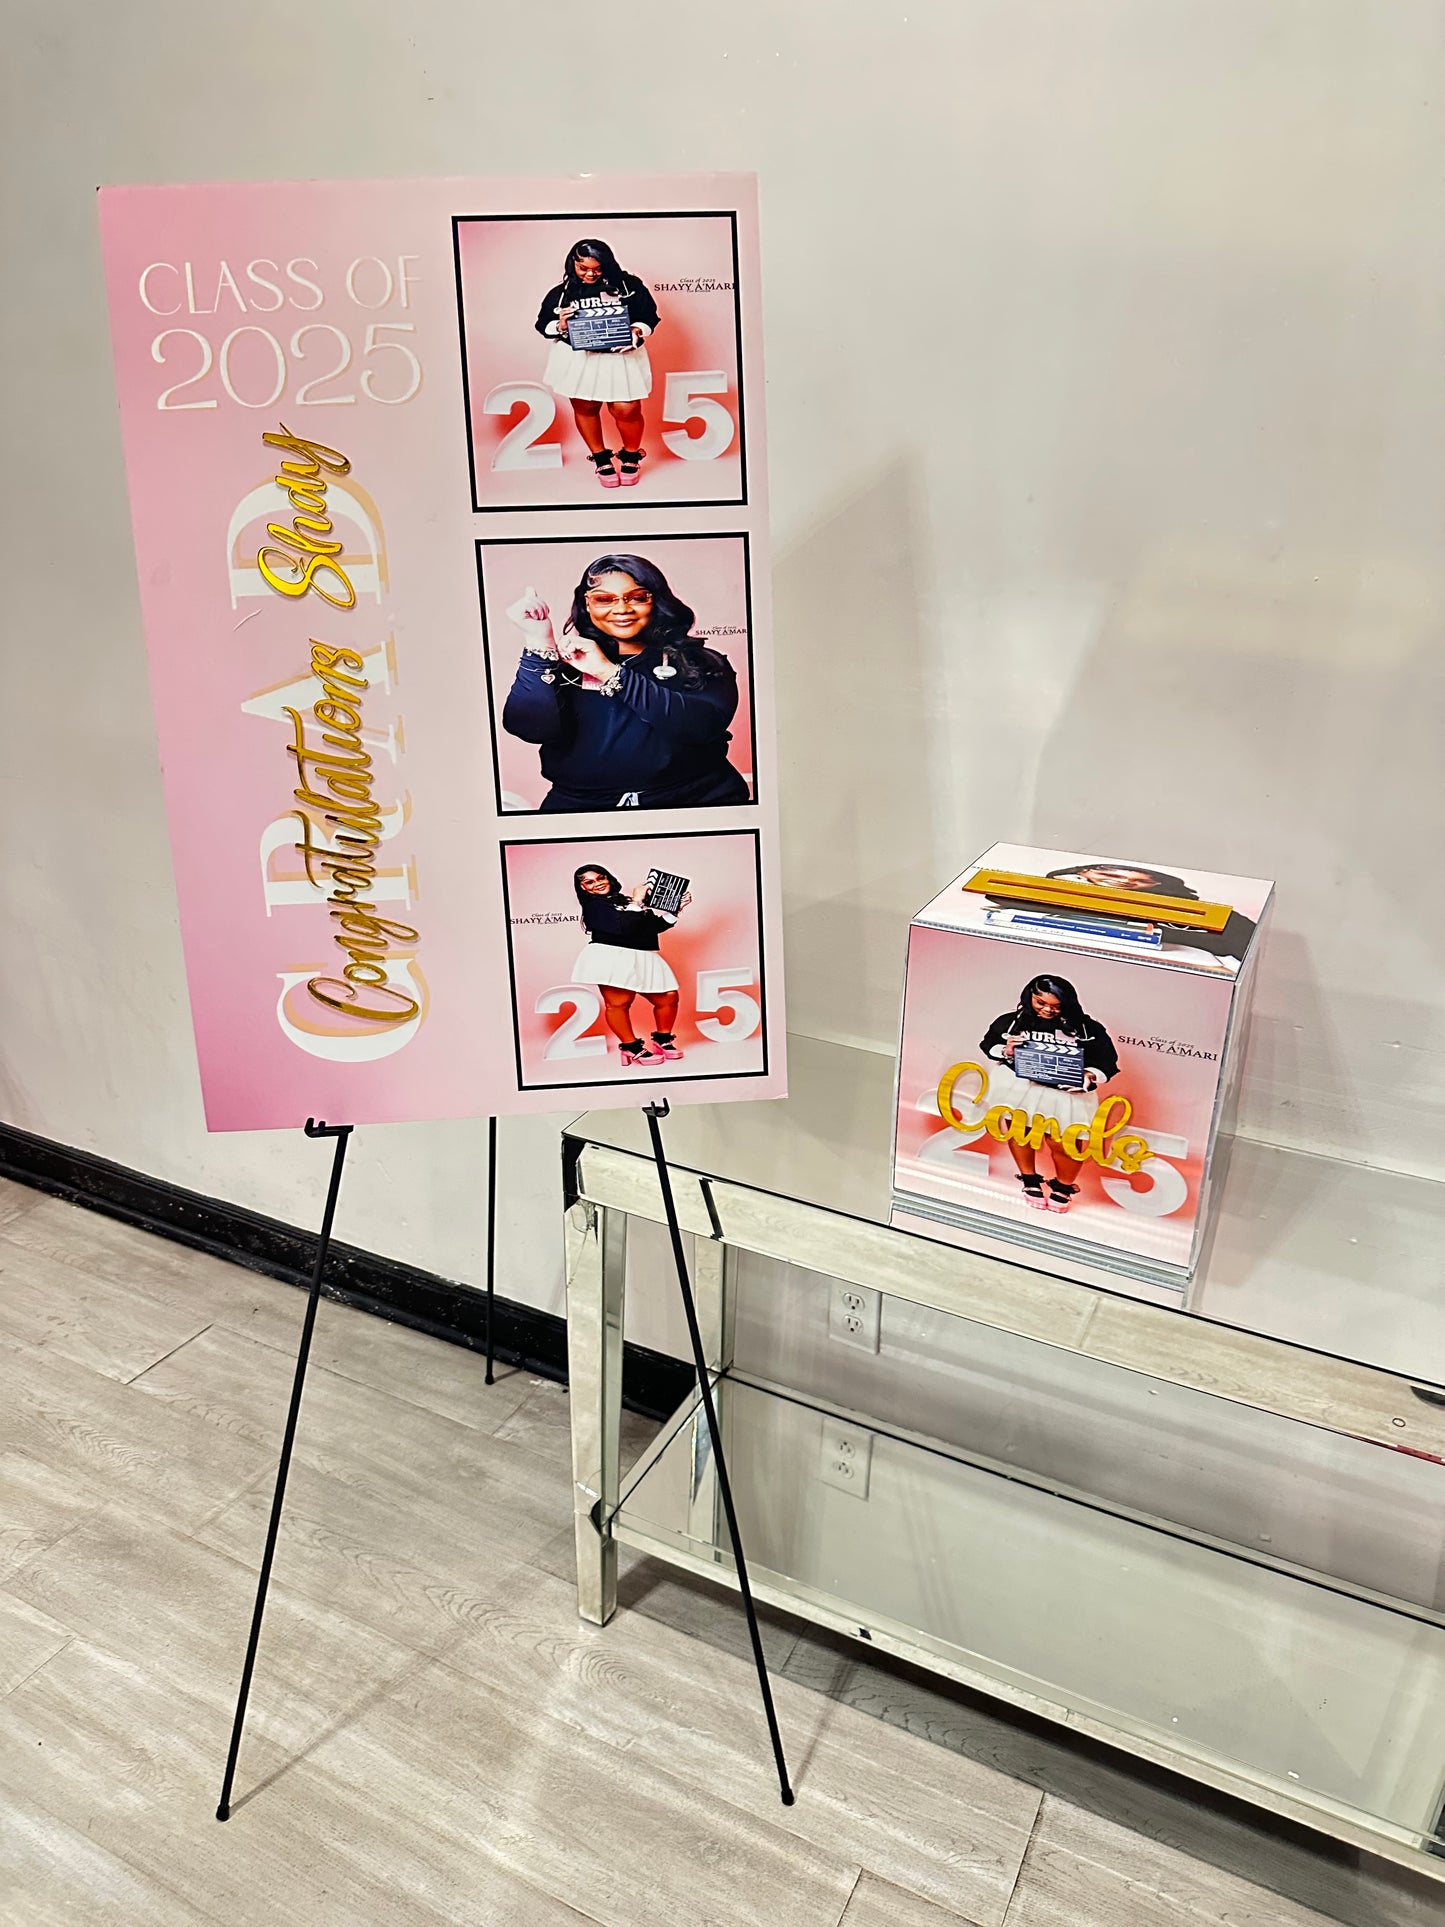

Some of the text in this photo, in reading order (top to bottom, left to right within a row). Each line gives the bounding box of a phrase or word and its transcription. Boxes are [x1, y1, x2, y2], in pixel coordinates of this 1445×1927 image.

[139, 255, 423, 316] CLASS OF
[653, 283, 693, 292] SHAYY
[151, 322, 423, 411] 2025
[483, 370, 735, 472] 2 5
[227, 474, 426, 1063] GRAD
[261, 422, 420, 1022] Congratulations Shay
[535, 967, 761, 1060] 2 5
[1117, 1035, 1164, 1051] SHAYY
[1166, 1045, 1218, 1061] A'MARI
[936, 1061, 1155, 1173] Cards
